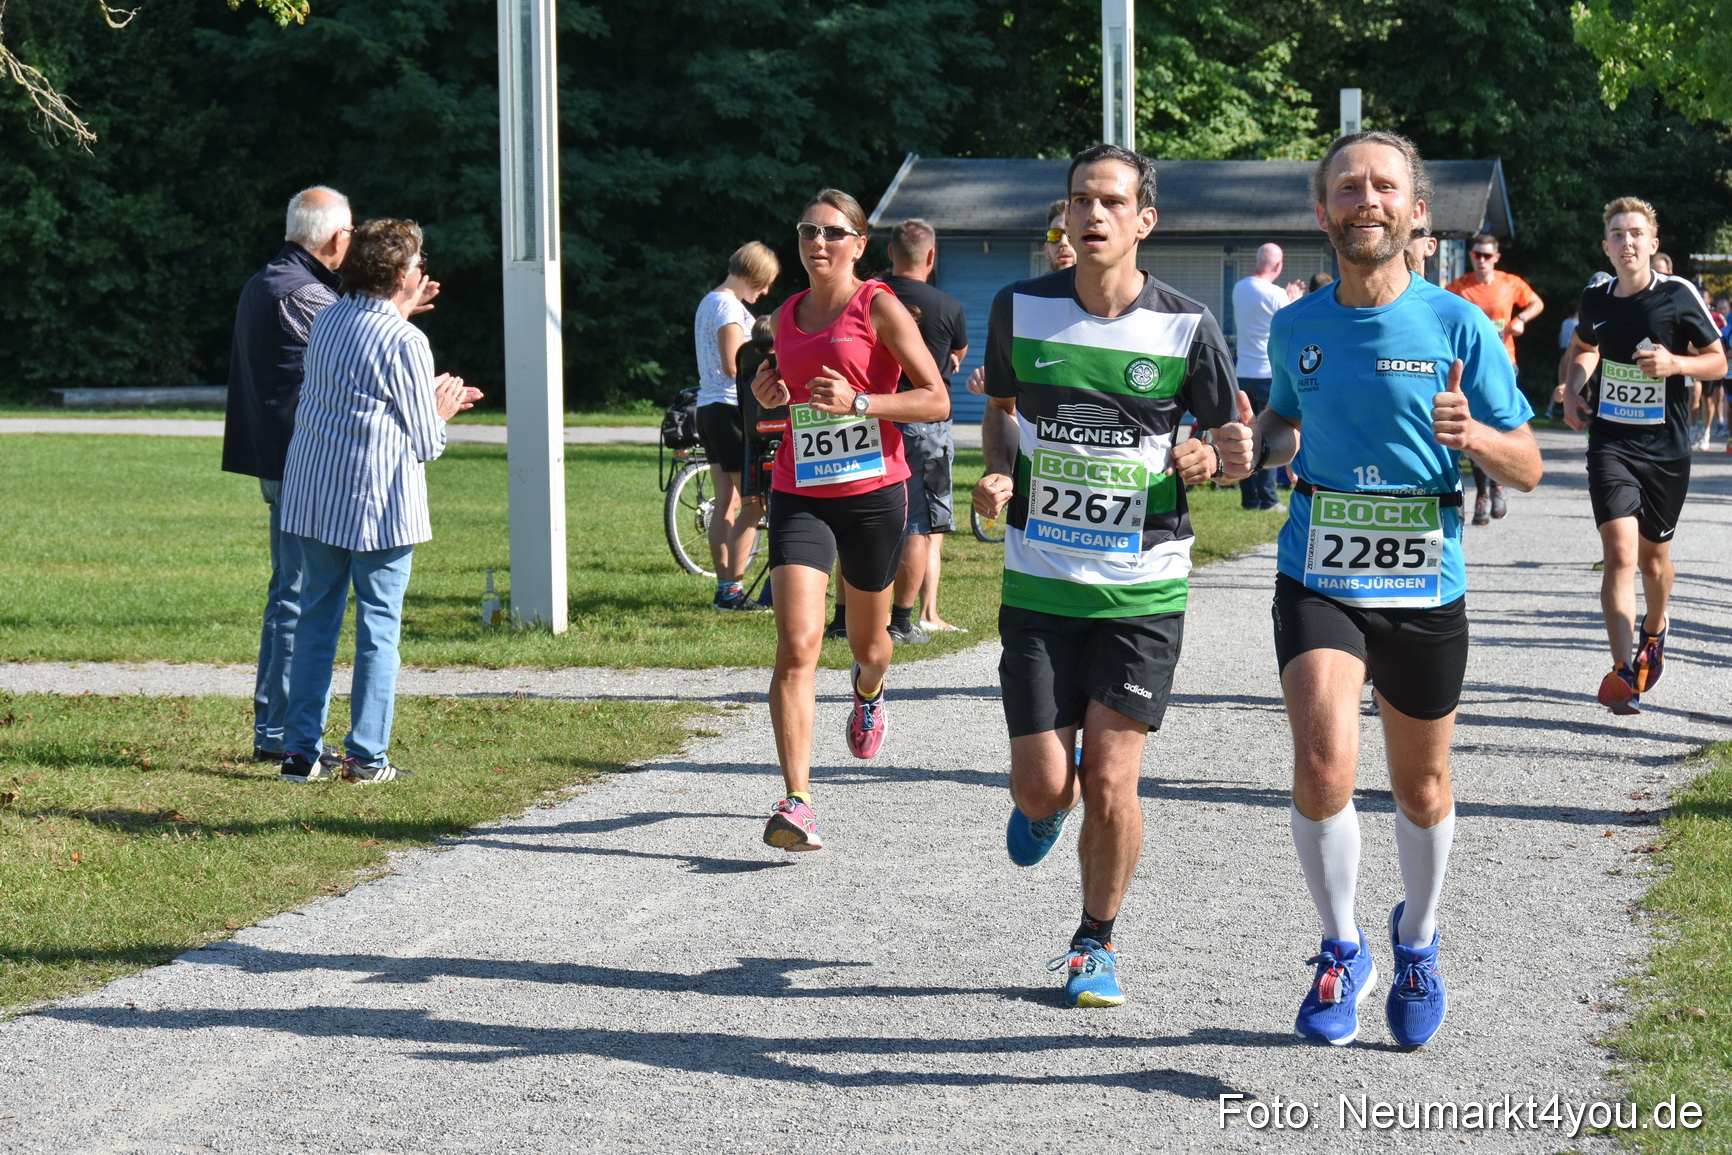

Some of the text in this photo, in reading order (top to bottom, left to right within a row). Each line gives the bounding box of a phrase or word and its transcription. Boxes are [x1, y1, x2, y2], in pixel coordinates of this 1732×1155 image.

[1376, 359, 1437, 374] BOCK
[1298, 378, 1319, 387] PARTL
[1606, 383, 1656, 404] 2622
[1614, 406, 1645, 418] LOUIS
[801, 425, 870, 458] 2612
[1040, 421, 1134, 445] MAGNERS
[814, 460, 861, 476] NADJA
[1041, 454, 1137, 486] BOCK
[1353, 465, 1388, 486] 18.
[1042, 485, 1132, 526] 2267
[1322, 499, 1429, 526] BOCK
[1037, 524, 1129, 549] WOLFGANG
[1322, 534, 1426, 569] 2285
[1317, 577, 1426, 590] HANS-JÜRGEN
[1123, 682, 1153, 699] adidas
